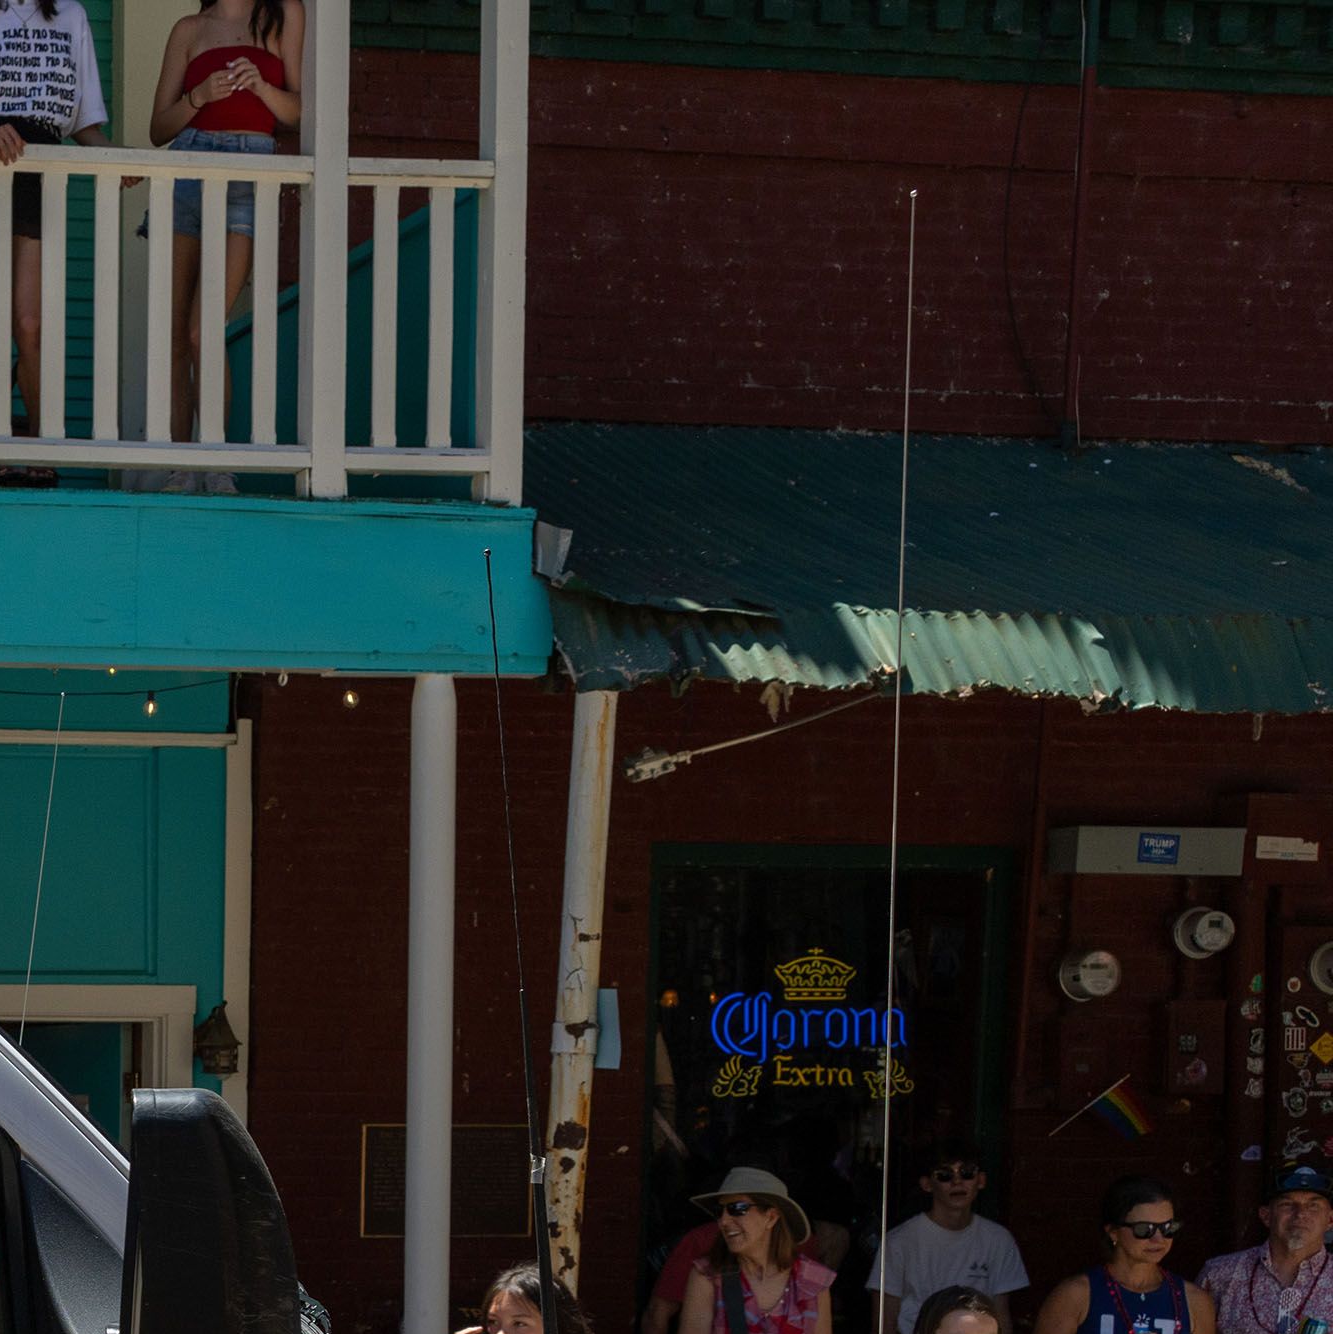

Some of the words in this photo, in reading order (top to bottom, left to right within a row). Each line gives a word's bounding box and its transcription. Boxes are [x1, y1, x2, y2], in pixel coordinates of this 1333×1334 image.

[2, 29, 30, 39] BLACK
[4, 41, 31, 53] WOMEN
[1143, 838, 1176, 849] TRUMP
[710, 991, 909, 1065] Corona
[771, 1054, 854, 1087] Extra
